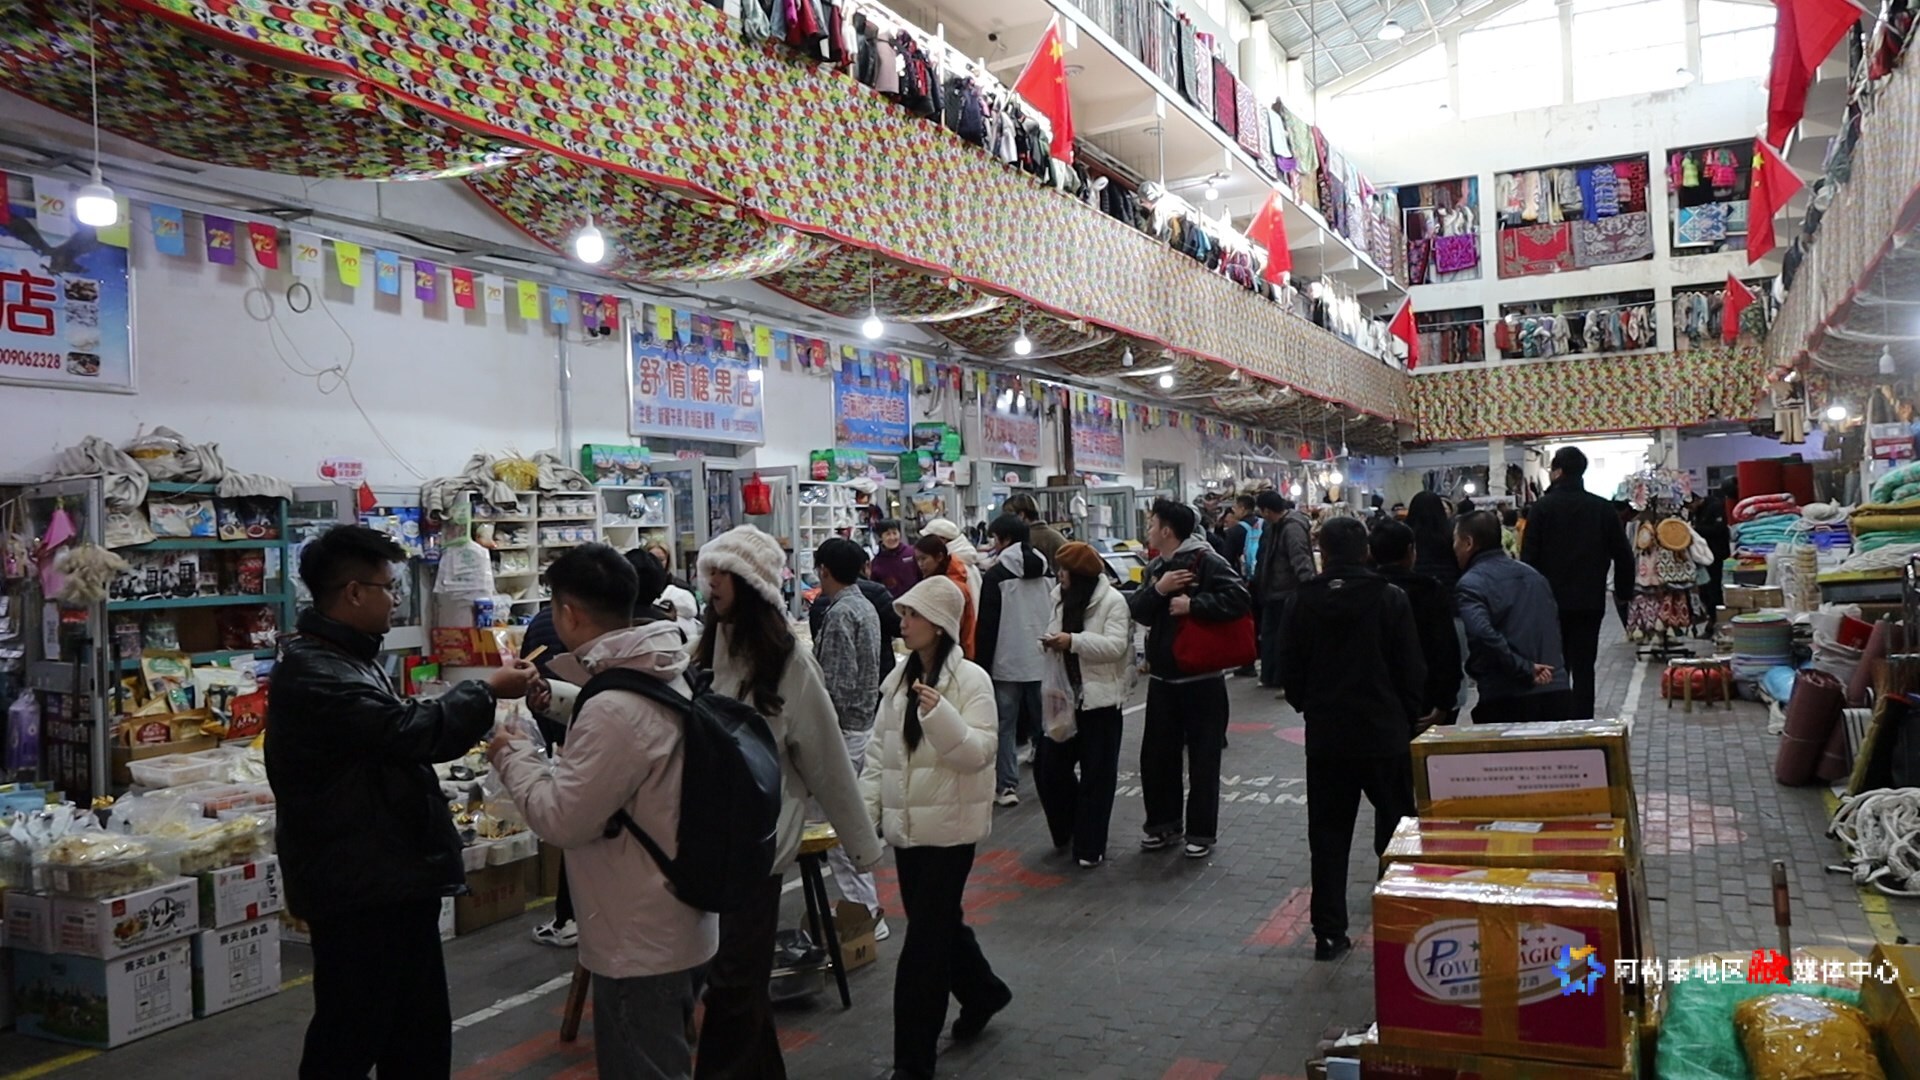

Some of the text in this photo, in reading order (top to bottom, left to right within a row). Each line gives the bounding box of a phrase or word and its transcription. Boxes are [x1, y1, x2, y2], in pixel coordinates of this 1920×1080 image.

[0, 269, 56, 336] 店
[639, 357, 755, 408] 舒情糖果店
[855, 945, 866, 961] M
[1424, 939, 1563, 980] POWE AGIC
